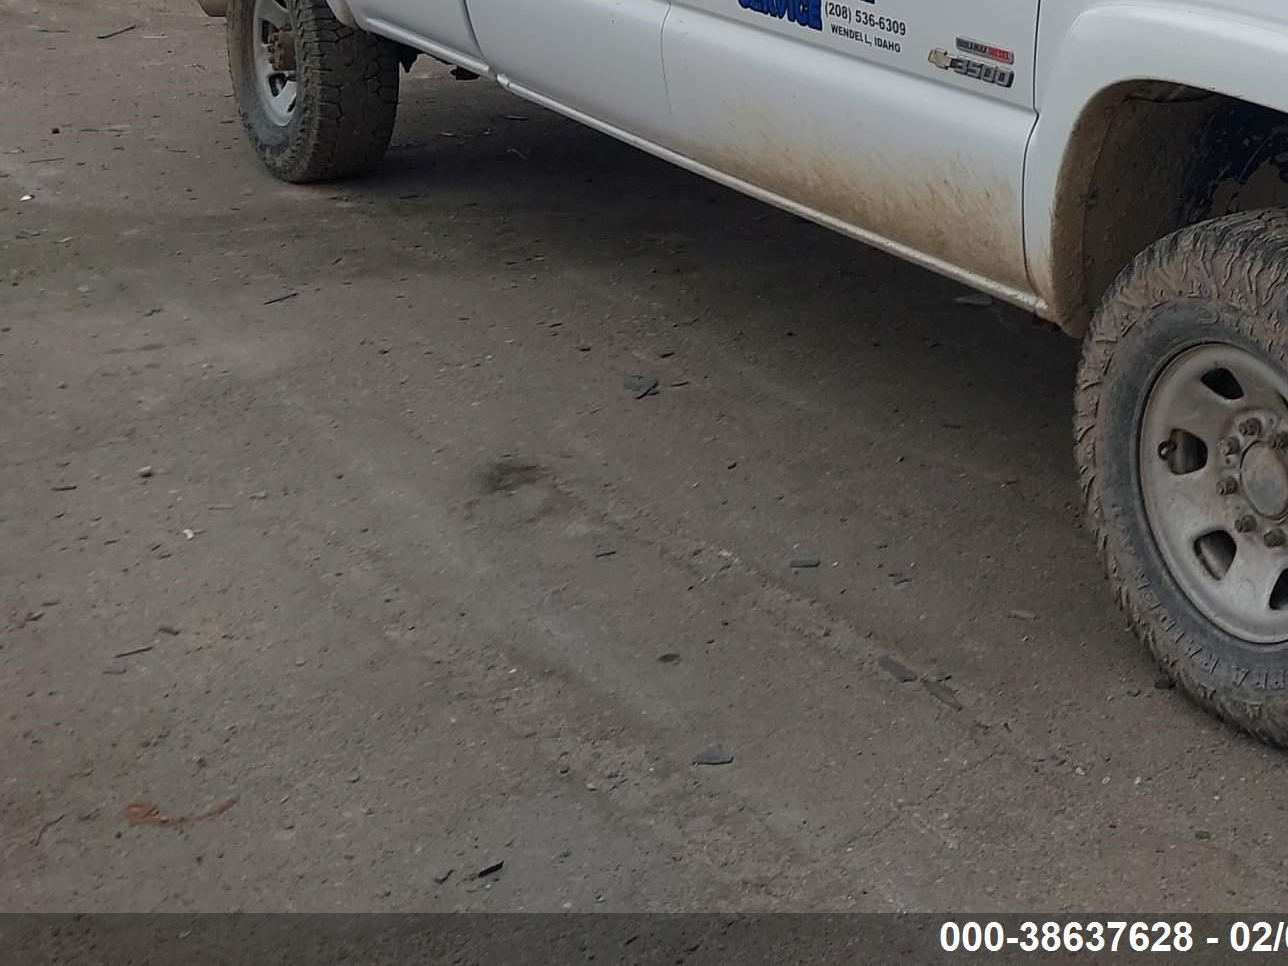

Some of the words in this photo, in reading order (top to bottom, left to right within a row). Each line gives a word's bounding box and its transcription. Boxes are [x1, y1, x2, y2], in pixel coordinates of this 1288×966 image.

[824, 0, 852, 25] (208)
[855, 9, 907, 37] 536-6309
[830, 23, 873, 48] WENDELL,
[874, 36, 901, 54] IDAHO
[952, 56, 1013, 88] 3500
